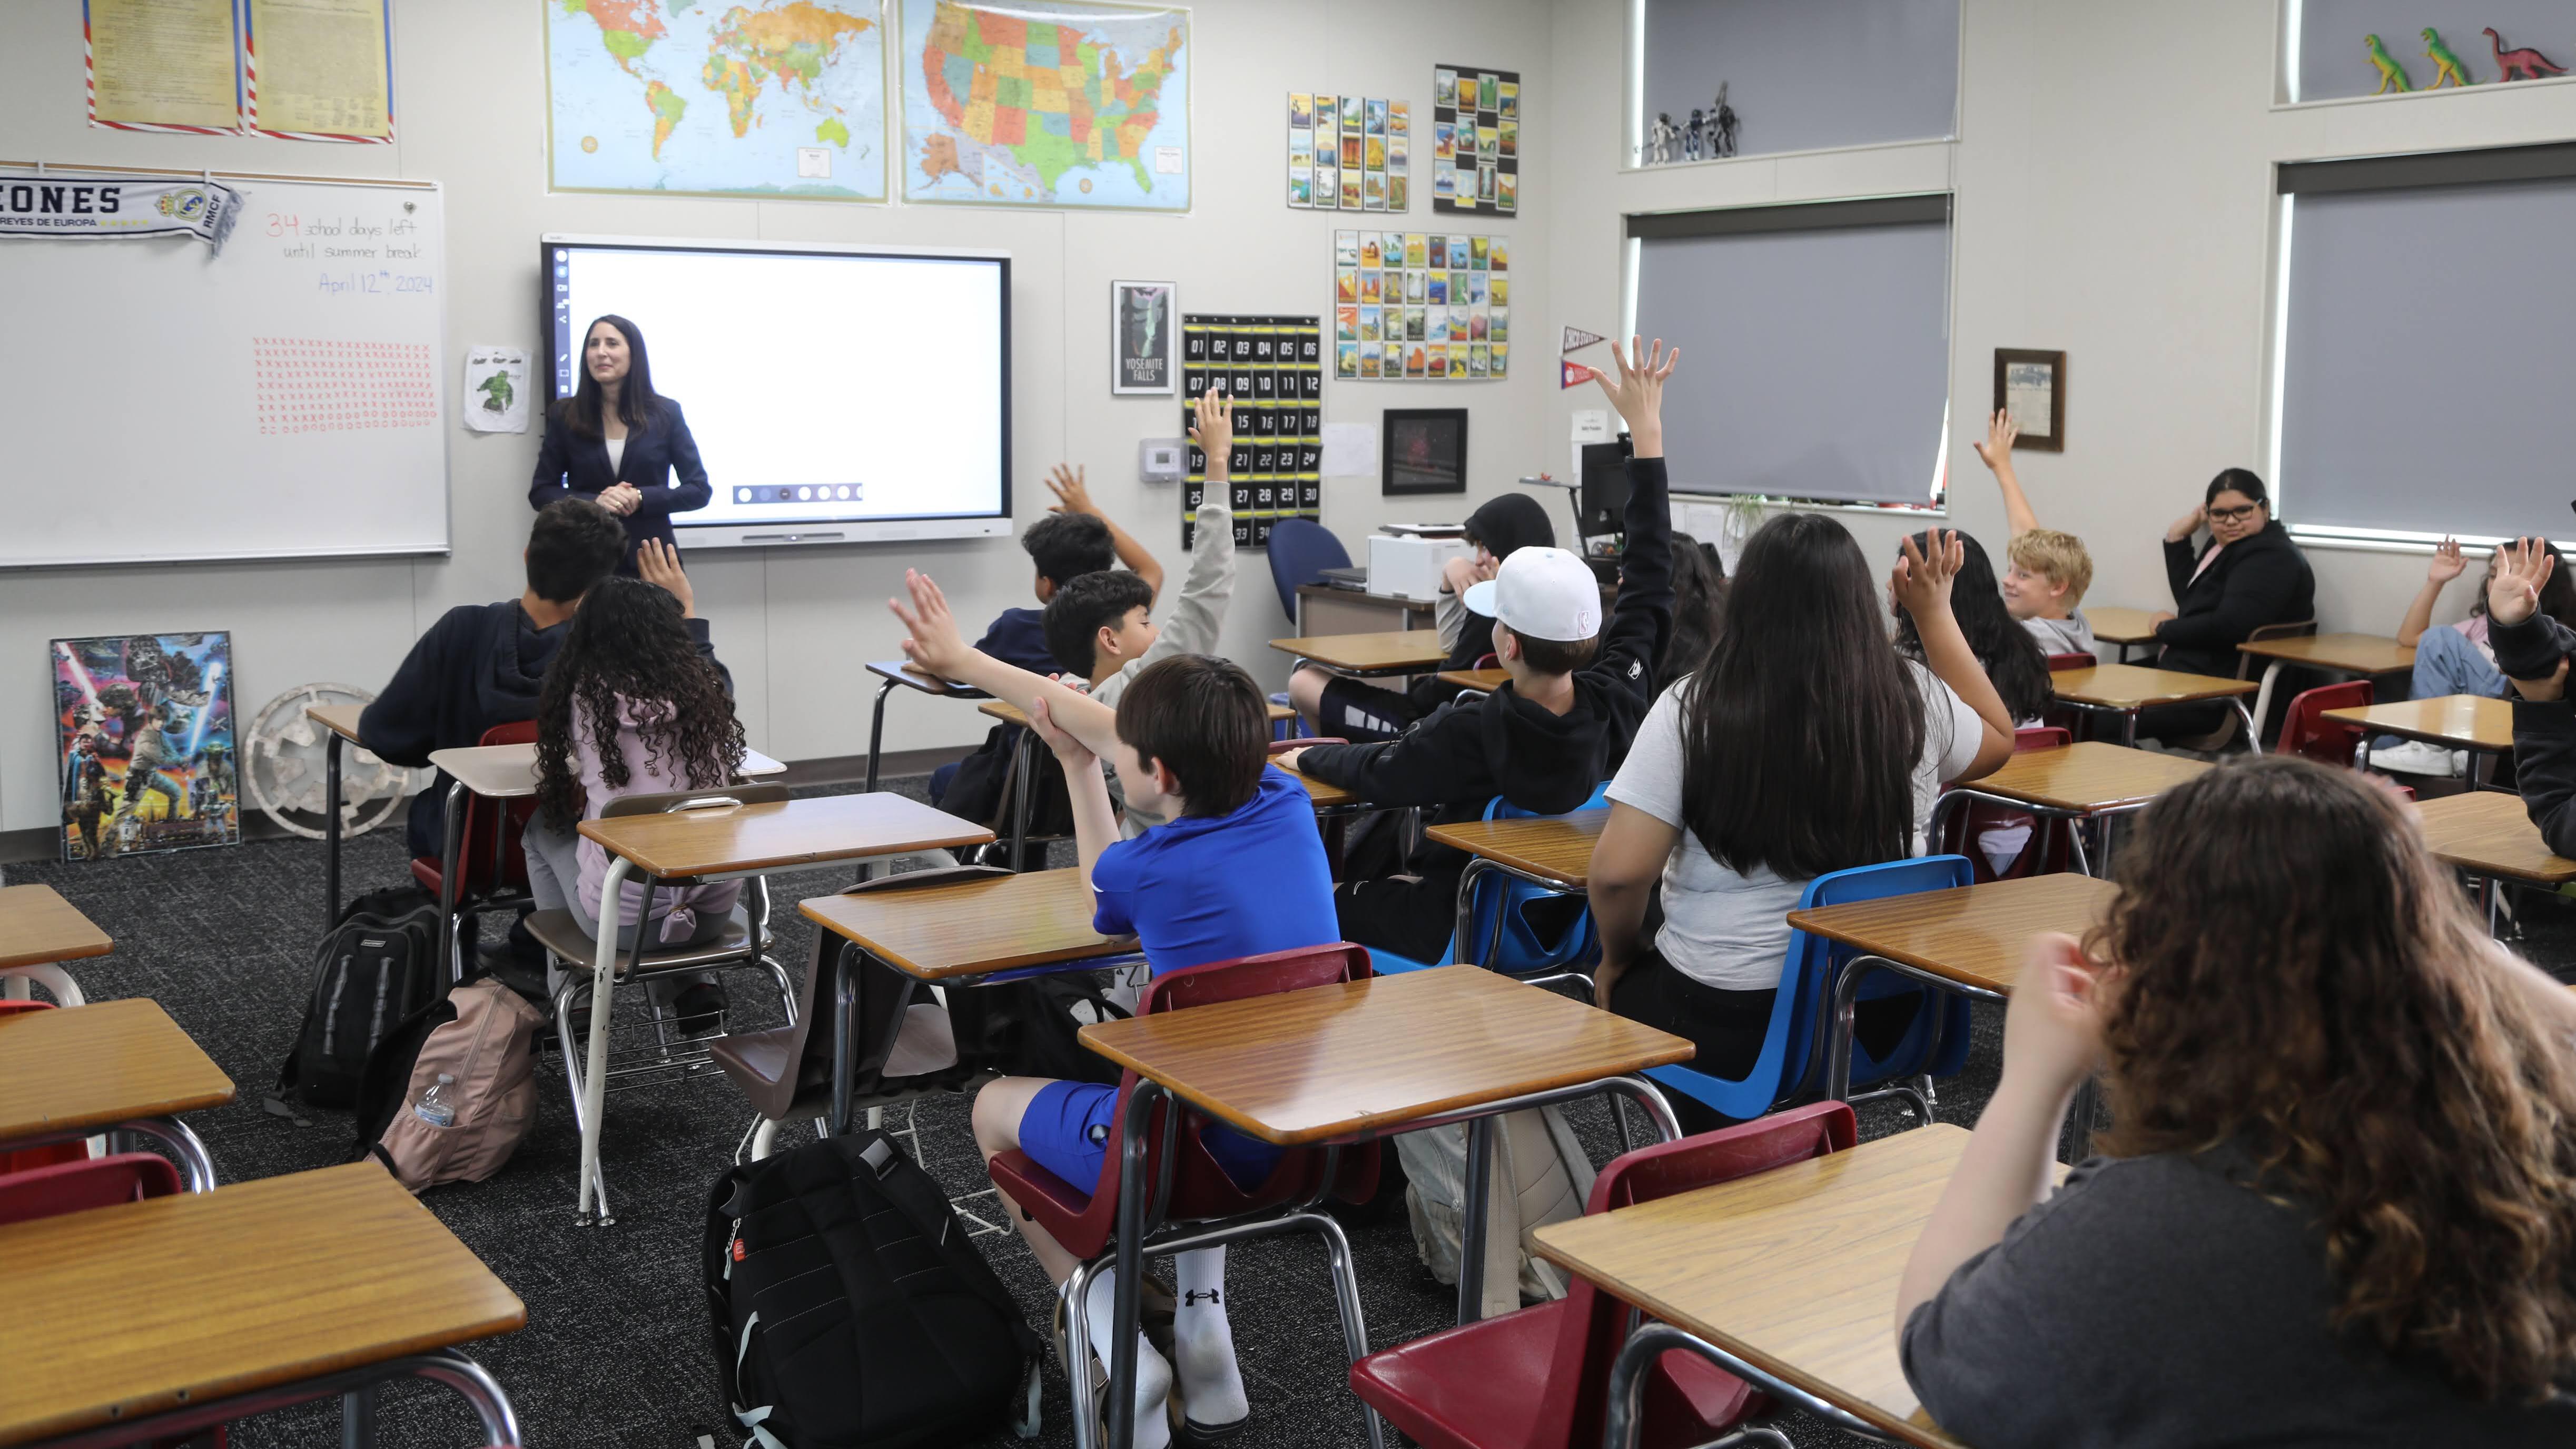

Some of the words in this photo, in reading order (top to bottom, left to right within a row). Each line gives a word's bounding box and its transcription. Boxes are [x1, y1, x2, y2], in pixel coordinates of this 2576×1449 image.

[0, 185, 121, 213] ONES
[203, 194, 221, 229] RMCF
[266, 213, 299, 237] 34
[304, 217, 342, 236] school
[349, 216, 382, 240] days
[389, 218, 417, 236] left
[284, 242, 315, 259] until
[324, 247, 377, 258] summer
[386, 243, 421, 259] break
[318, 273, 354, 296] April
[396, 275, 432, 295] 2024
[1191, 340, 1203, 353] 01
[1213, 340, 1227, 353] 02
[1236, 341, 1249, 354] 03
[1258, 342, 1271, 355] 04
[1280, 342, 1294, 355] 05
[1304, 343, 1317, 356] 06
[1126, 358, 1163, 369] YOSEMITE
[1134, 369, 1155, 380] FALLS
[1190, 377, 1203, 390] 07
[1236, 377, 1249, 390] 09
[1259, 377, 1271, 390] 10
[1284, 377, 1294, 390] 11
[1307, 377, 1318, 390] 12
[1238, 416, 1249, 428] 15
[1262, 416, 1273, 429] 16
[1284, 416, 1296, 428] 17
[1307, 416, 1317, 428] 18
[1191, 455, 1203, 467] 19
[1236, 454, 1248, 466] 21
[1260, 454, 1272, 466] 22
[1280, 453, 1293, 466] 23
[1191, 491, 1201, 505] 25
[1237, 490, 1248, 503] 27
[1259, 489, 1271, 502] 28
[1281, 488, 1294, 501] 29
[1305, 488, 1317, 501] 30
[1235, 528, 1248, 540] 33
